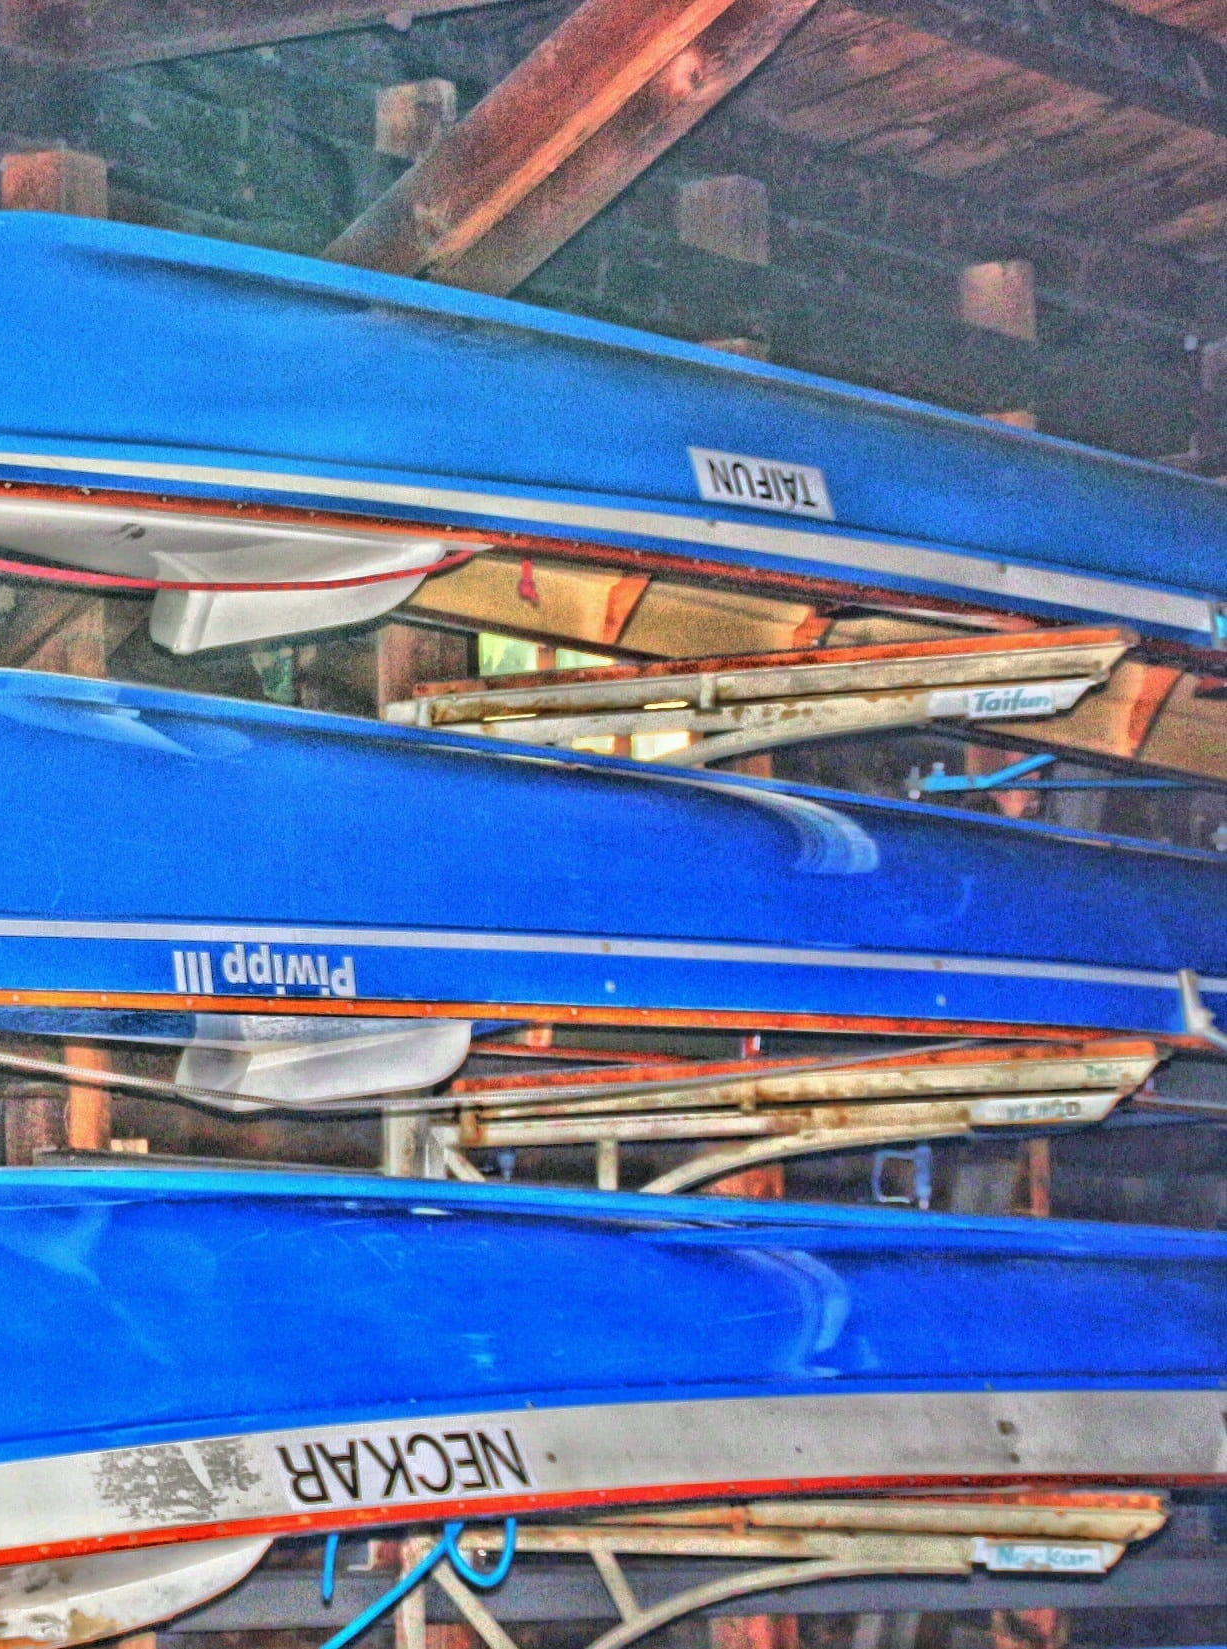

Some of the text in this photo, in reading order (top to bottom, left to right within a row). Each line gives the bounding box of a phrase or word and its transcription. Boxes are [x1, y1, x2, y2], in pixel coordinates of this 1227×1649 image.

[706, 458, 818, 509] TAIFUN
[973, 689, 1050, 713] Taifun
[173, 944, 357, 996] Piwipp III
[276, 1430, 529, 1505] NECKAR
